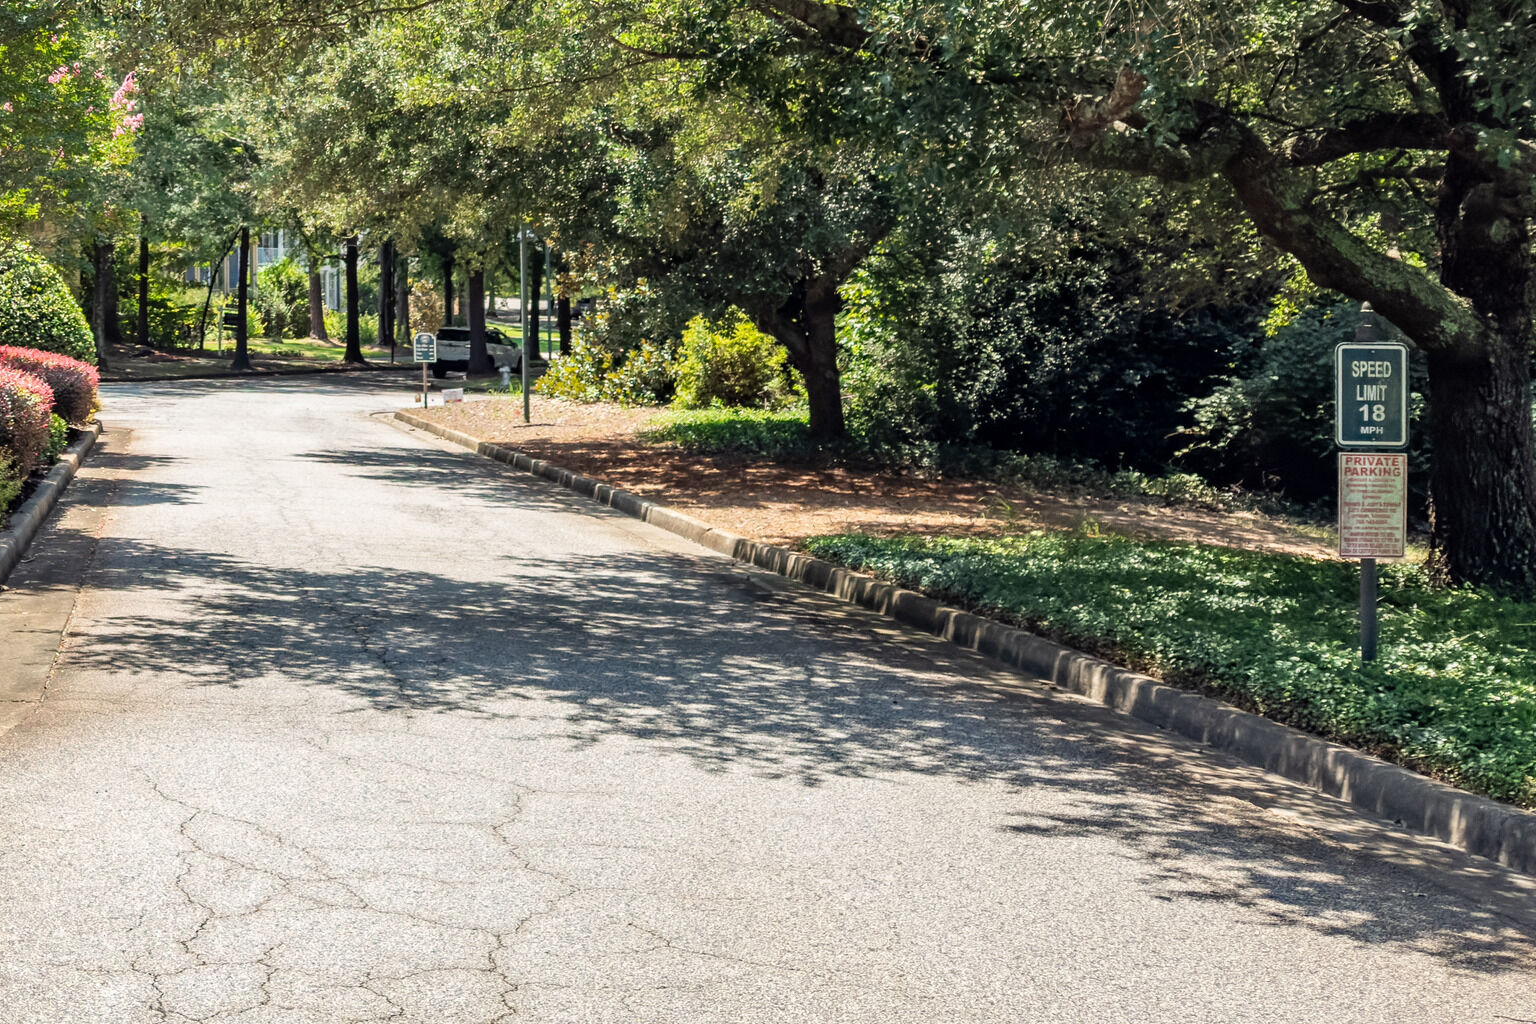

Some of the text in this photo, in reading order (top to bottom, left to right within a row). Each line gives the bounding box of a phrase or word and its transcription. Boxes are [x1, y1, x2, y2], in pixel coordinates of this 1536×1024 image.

[1351, 361, 1392, 378] SPEED
[1356, 384, 1387, 401] LIMIT
[1359, 404, 1386, 422] 18
[1360, 426, 1383, 435] MPH
[1345, 456, 1399, 467] PRIVATE
[1344, 467, 1401, 477] PARKING
